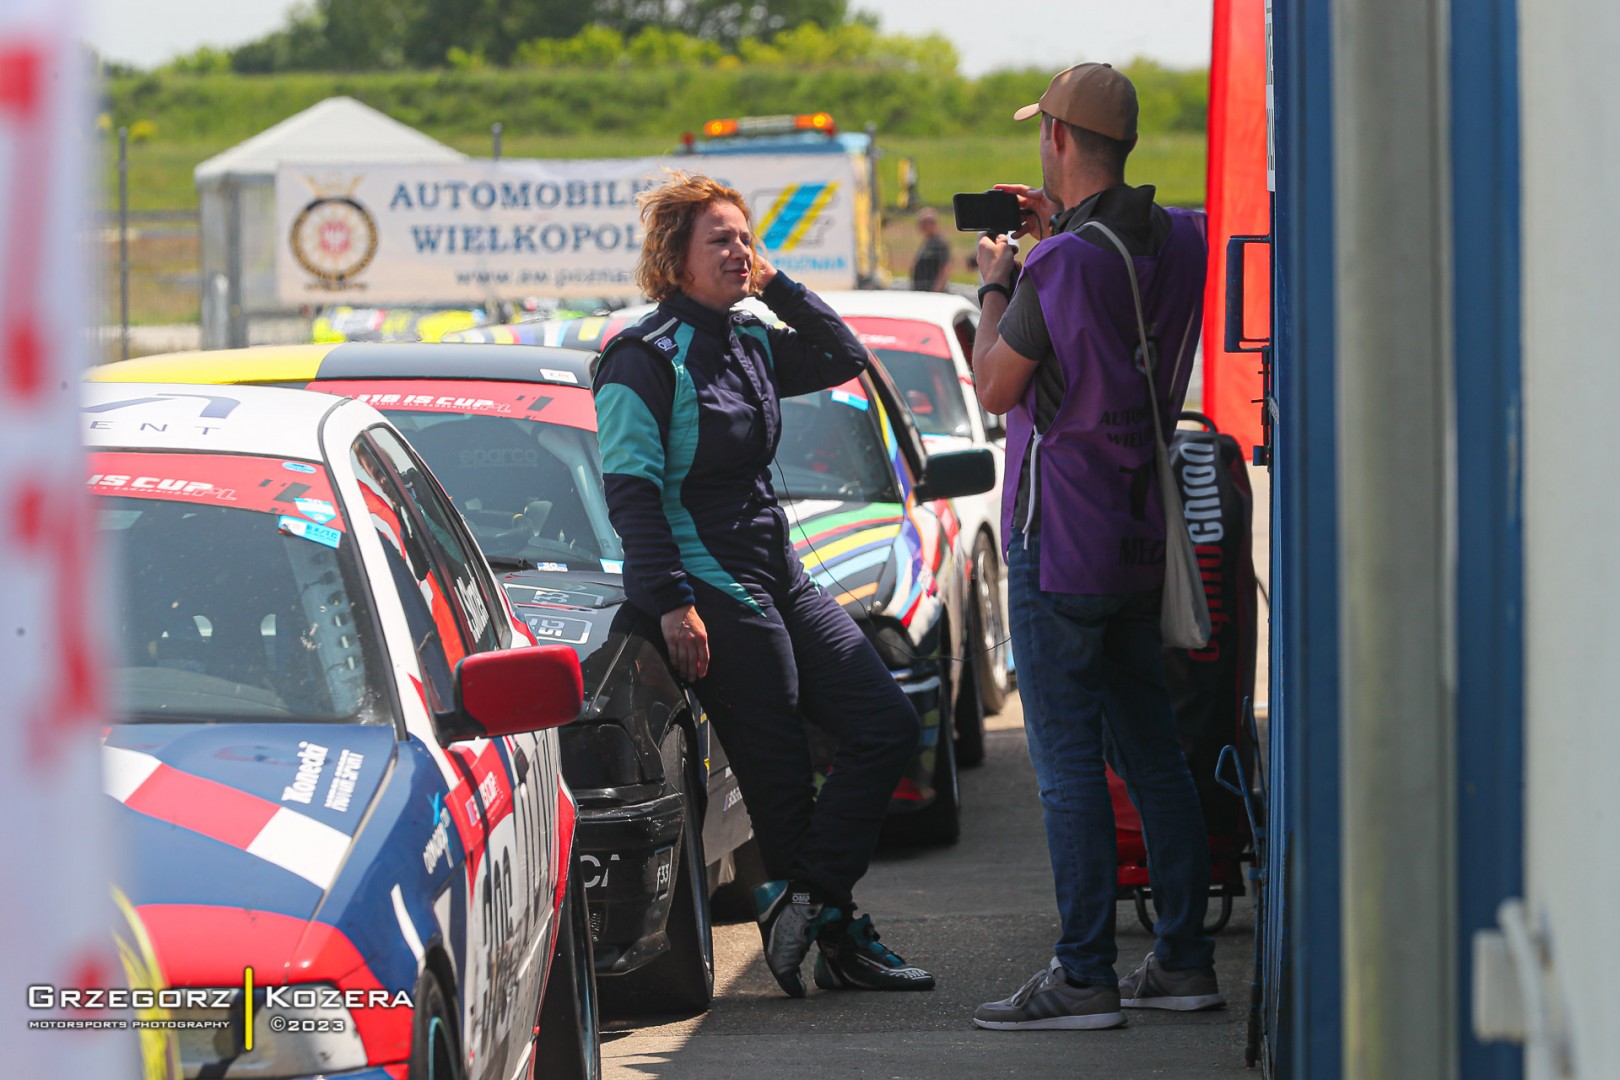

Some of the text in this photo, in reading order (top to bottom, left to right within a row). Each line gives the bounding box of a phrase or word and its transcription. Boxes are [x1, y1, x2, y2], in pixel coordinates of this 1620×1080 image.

[391, 181, 732, 208] AUTOMOBIL
[412, 223, 642, 252] WIELKOPOL
[455, 268, 636, 288] www.aw.pozna
[402, 394, 435, 405] IS
[435, 397, 495, 408] CUP
[1099, 408, 1155, 426] AUTO
[131, 476, 214, 492] CUP
